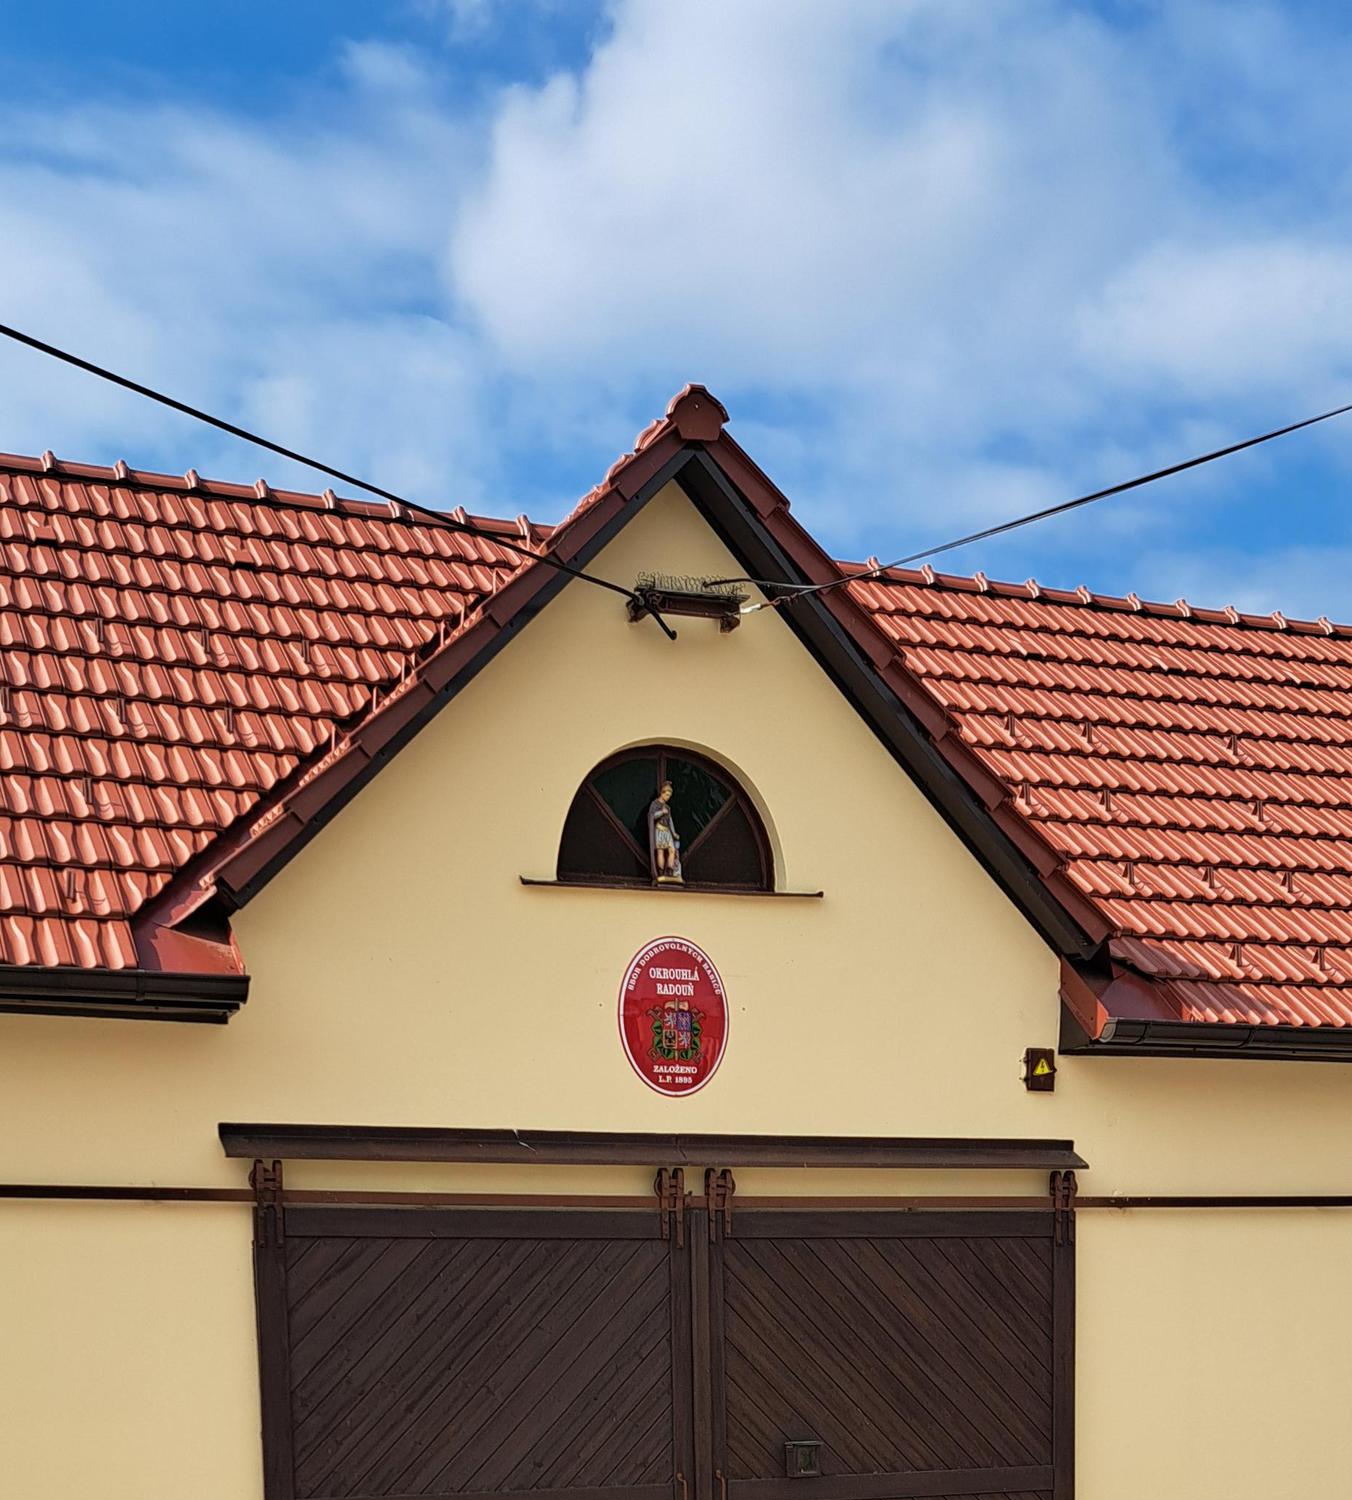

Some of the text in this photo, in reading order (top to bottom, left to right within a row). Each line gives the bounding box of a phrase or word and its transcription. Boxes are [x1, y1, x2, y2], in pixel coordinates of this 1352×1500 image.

[627, 967, 642, 991] SBOR
[649, 966, 700, 981] OKROUHLÁ
[656, 982, 694, 996] RADOUŇ
[653, 1064, 698, 1074] ZALOŽENO
